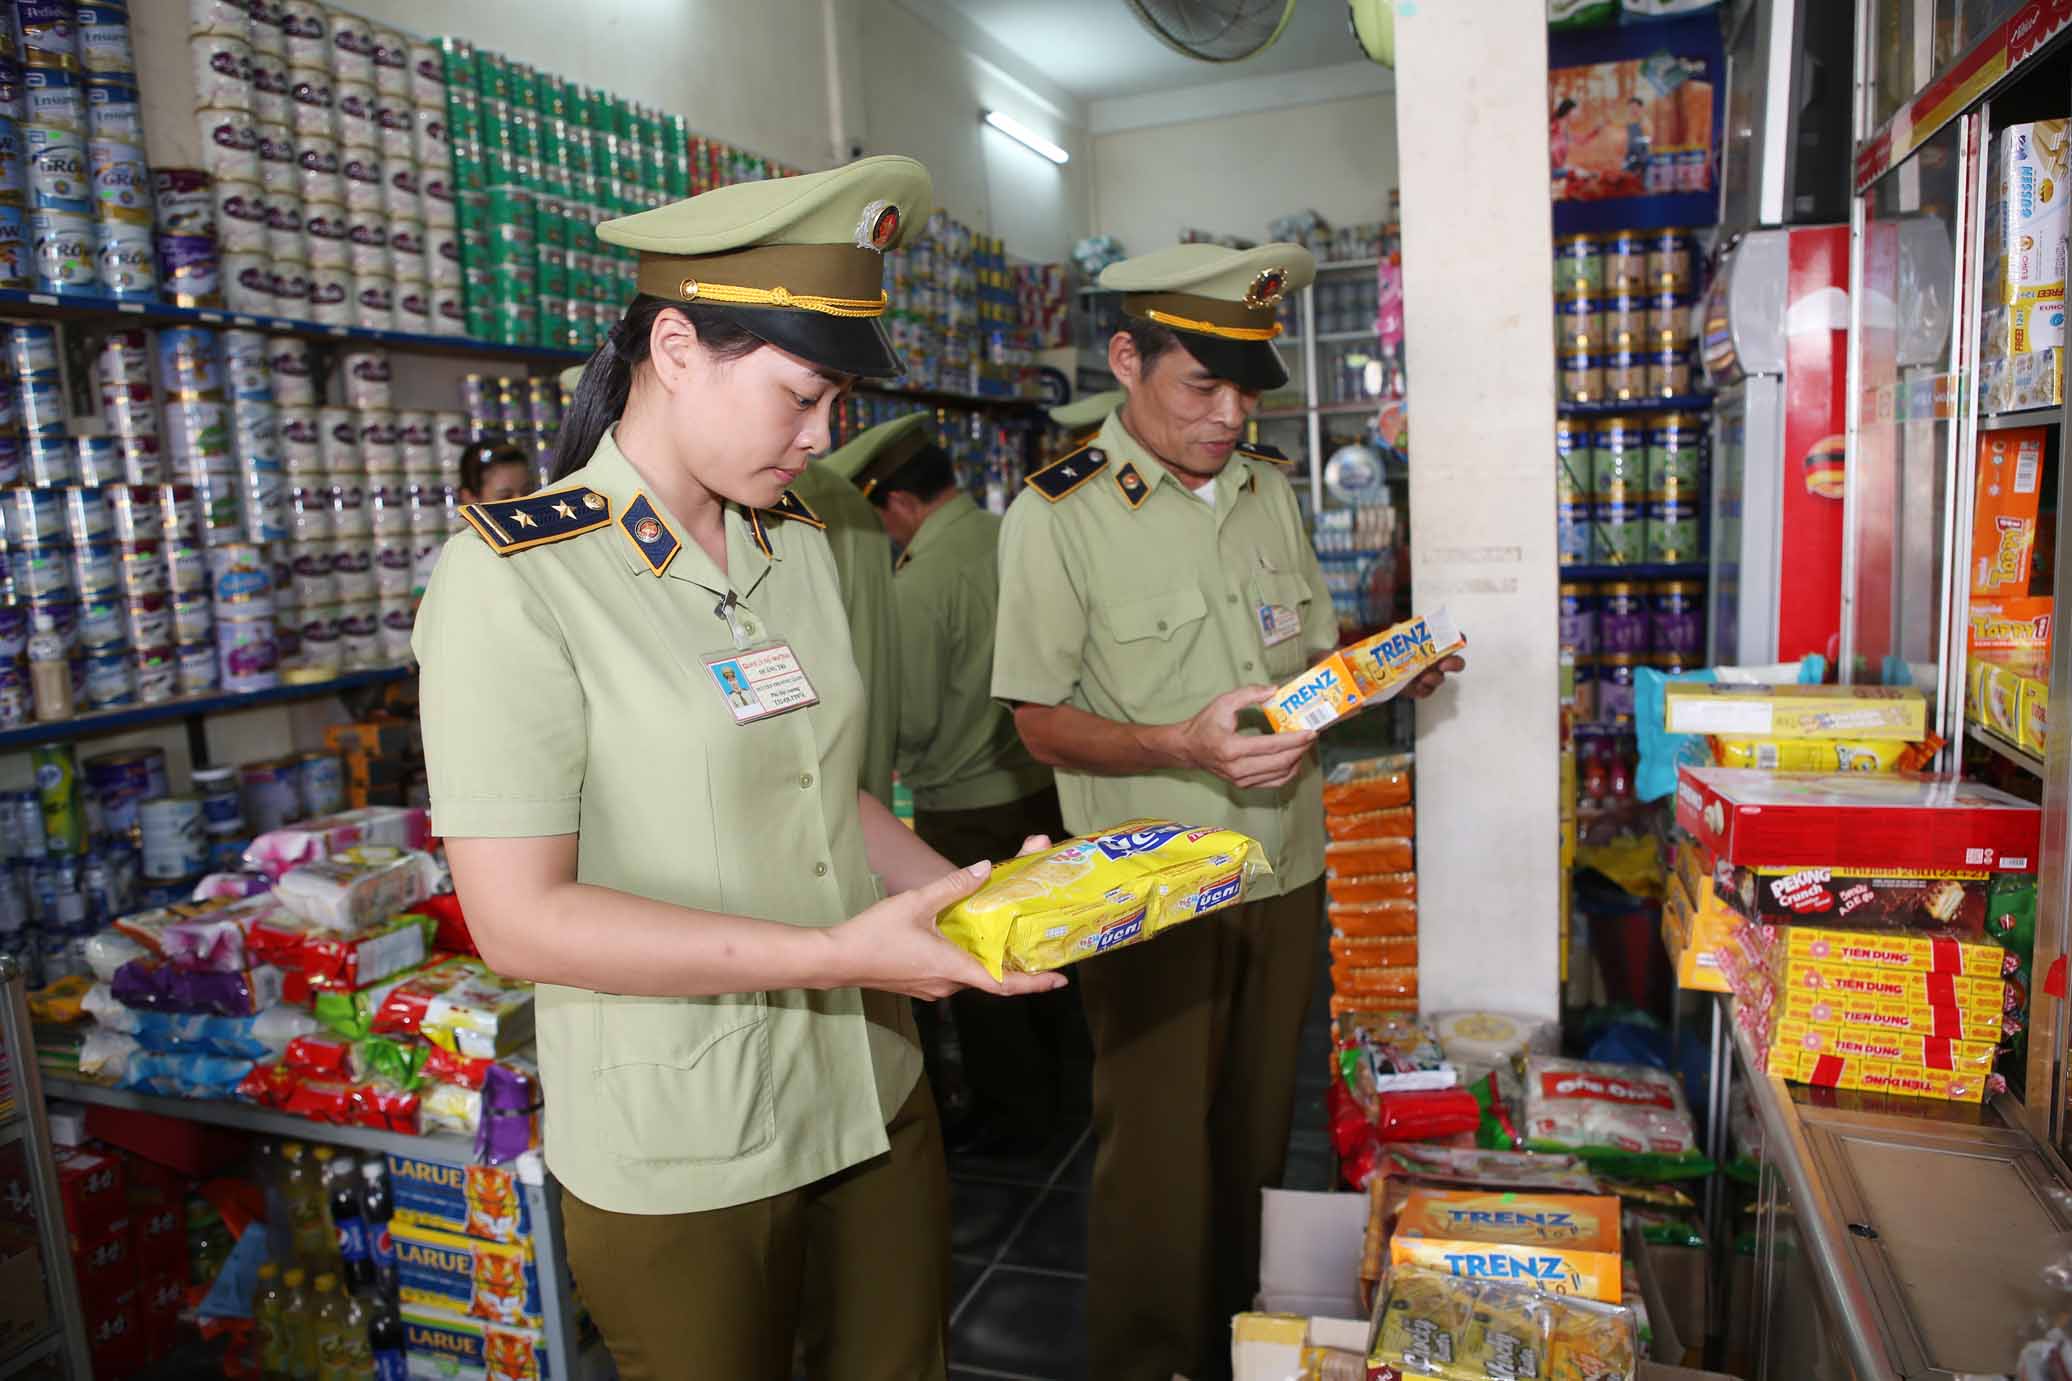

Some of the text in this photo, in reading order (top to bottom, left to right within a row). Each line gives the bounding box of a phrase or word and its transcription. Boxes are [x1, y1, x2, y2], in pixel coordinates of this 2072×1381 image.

[1370, 621, 1431, 667] TRENZ
[1280, 668, 1338, 715] TRENZ
[1770, 868, 1832, 899] PEKING
[1779, 884, 1824, 907] Crunch
[388, 1156, 464, 1188] LARUE
[1448, 1210, 1573, 1227] TRENZ
[395, 1243, 470, 1274] LARUE
[1444, 1254, 1567, 1280] TRENZ
[408, 1327, 476, 1354] LARUE
